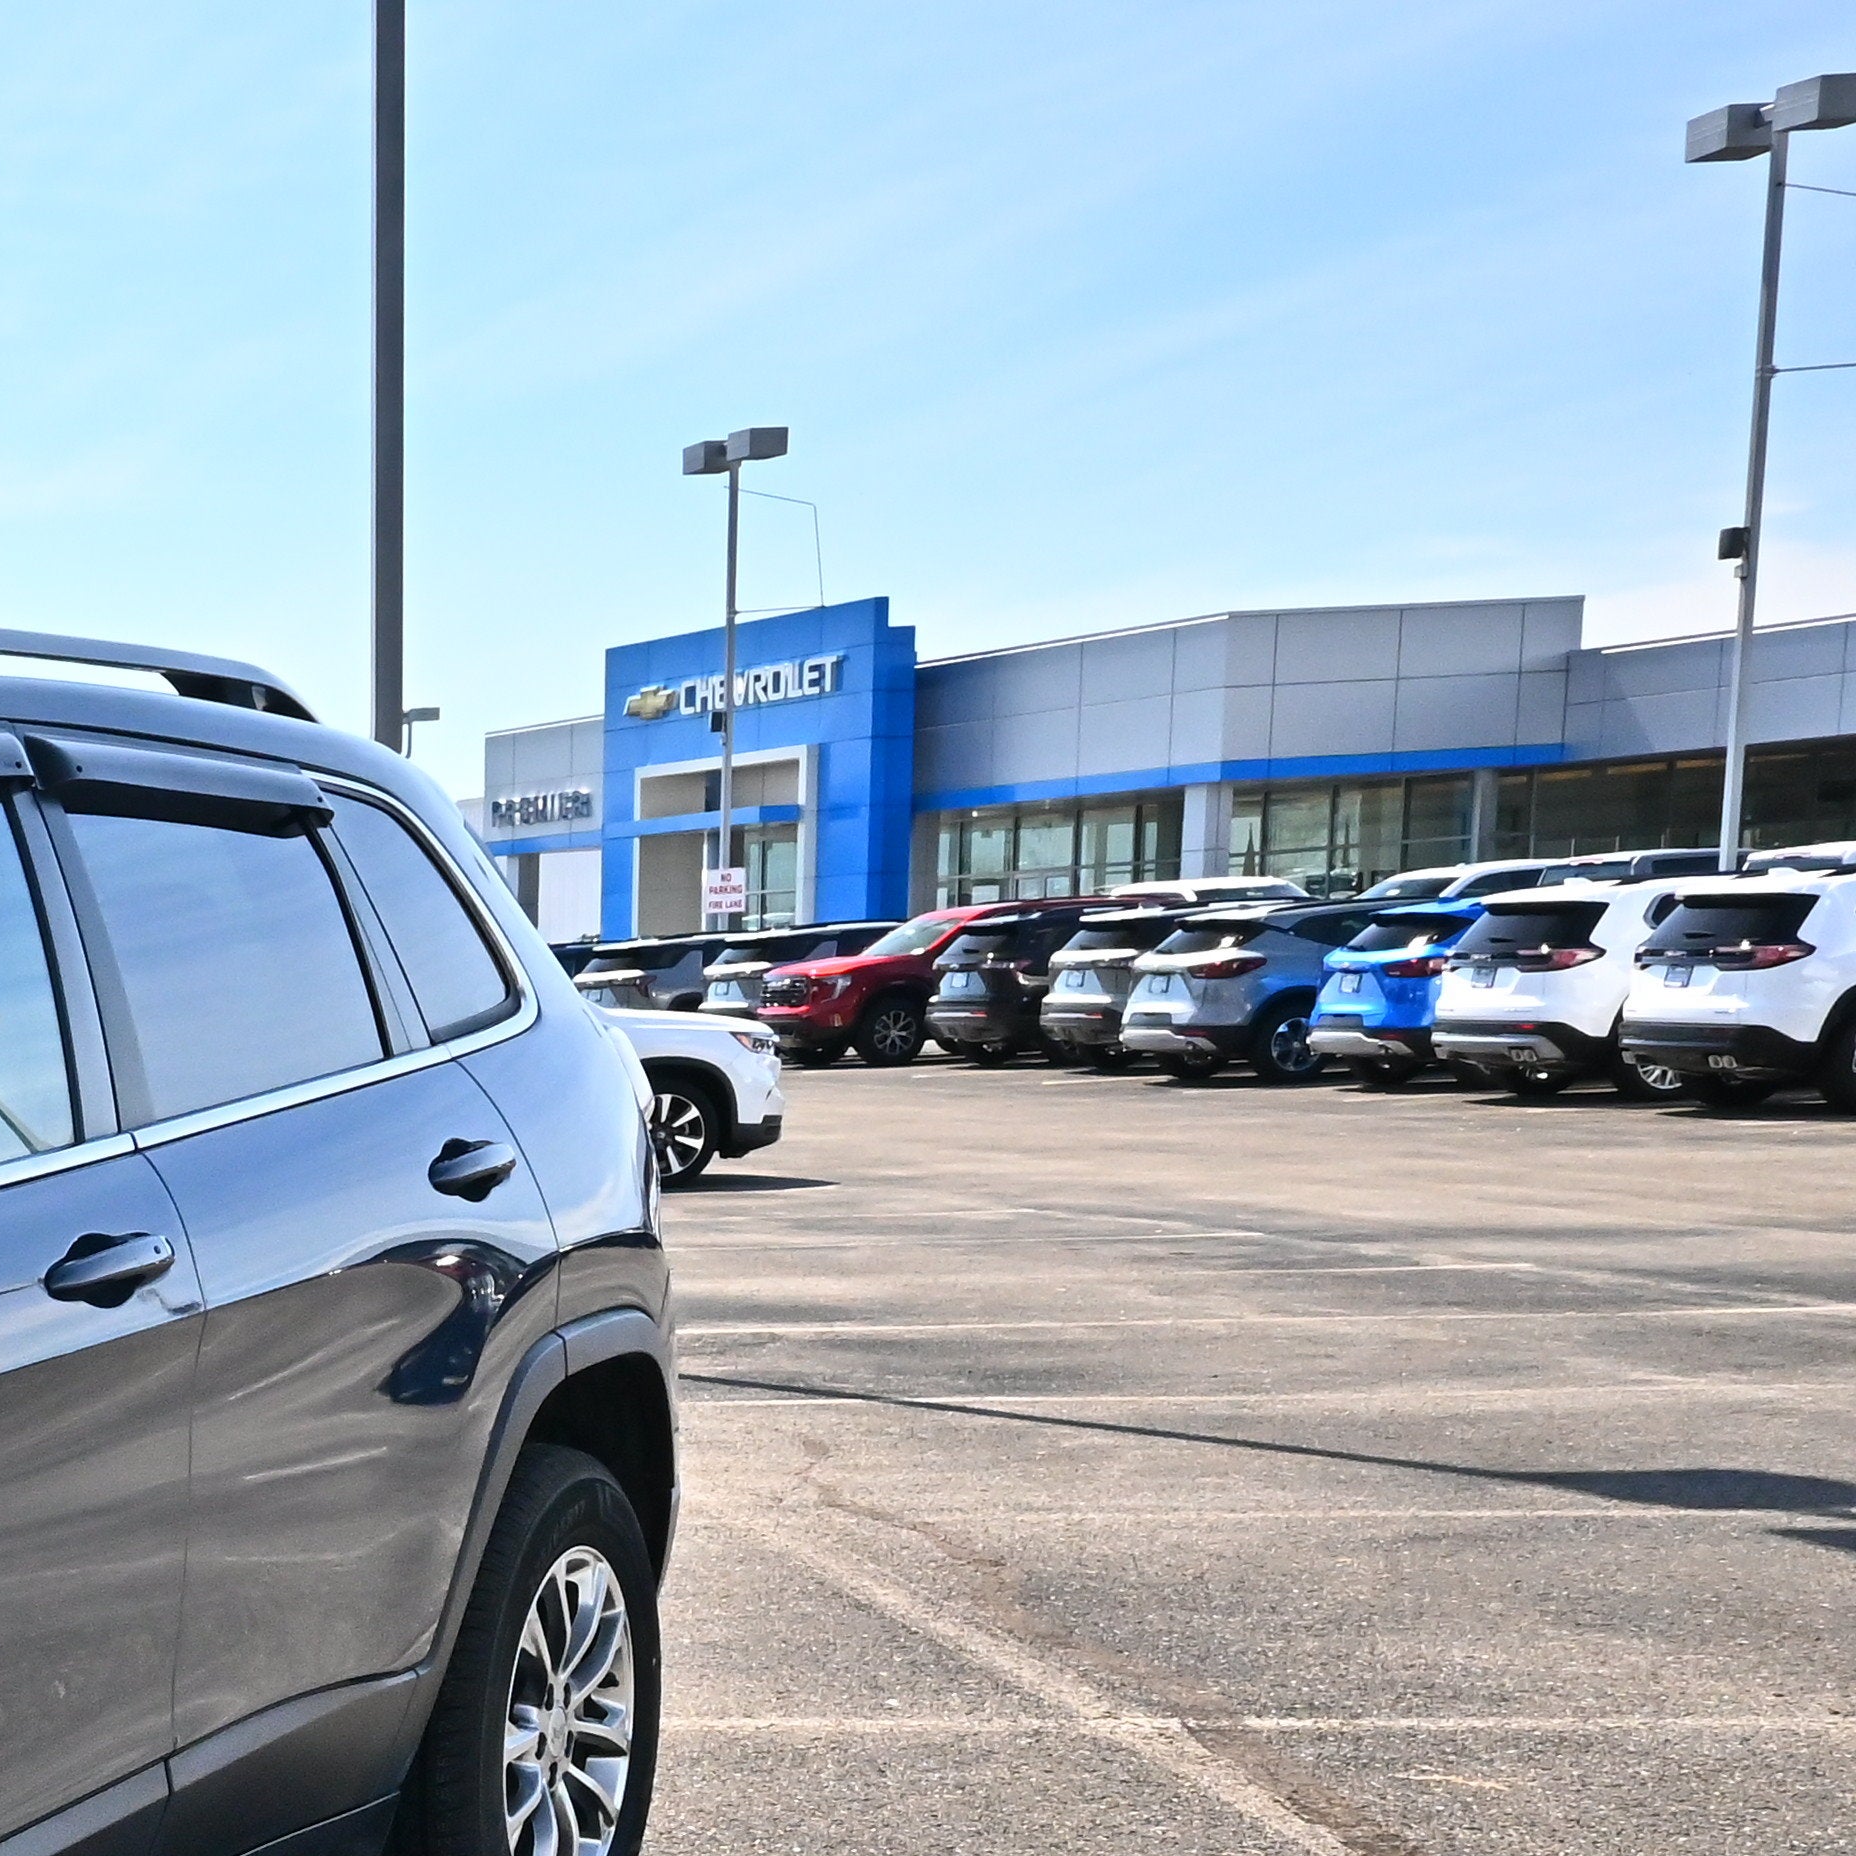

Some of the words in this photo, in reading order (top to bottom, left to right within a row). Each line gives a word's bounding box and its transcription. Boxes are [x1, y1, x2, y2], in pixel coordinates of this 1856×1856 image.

[679, 655, 838, 715] CHEVROLET
[721, 873, 731, 882] NO
[709, 884, 742, 894] PARKING
